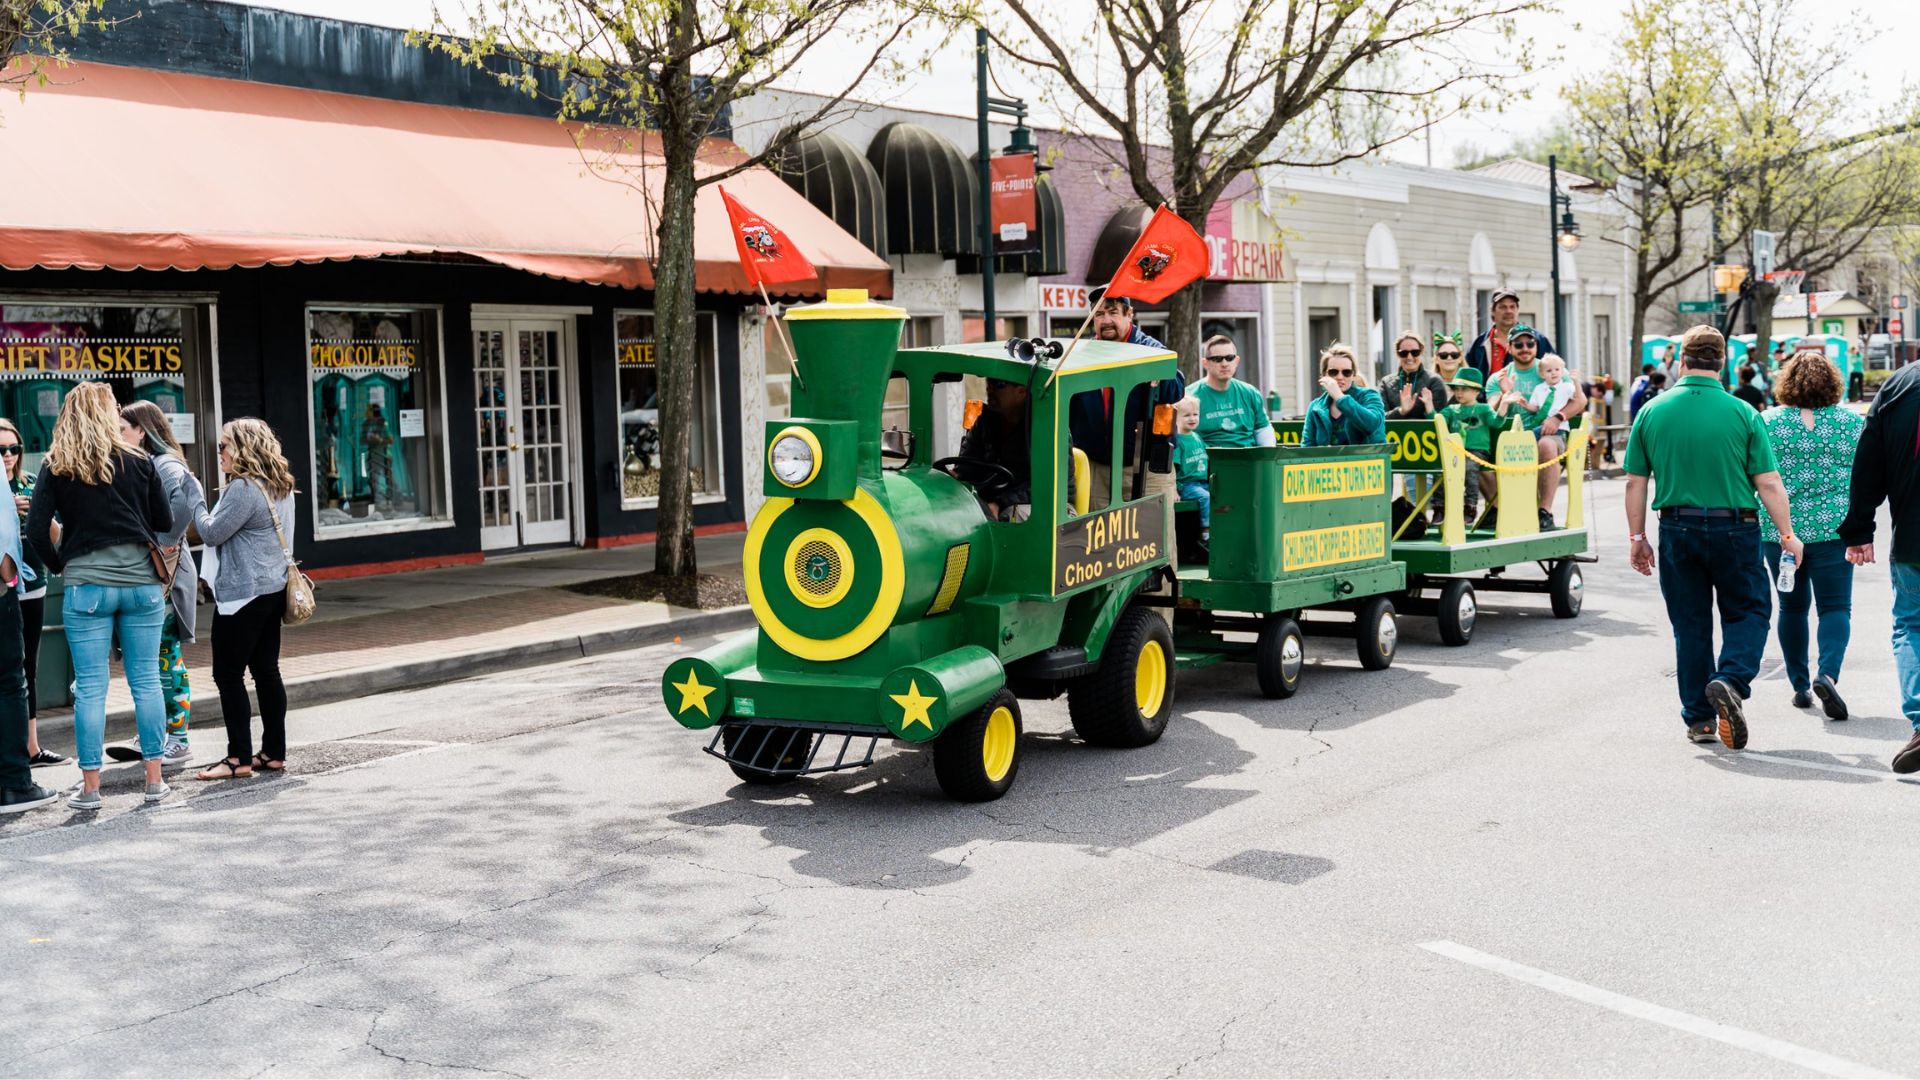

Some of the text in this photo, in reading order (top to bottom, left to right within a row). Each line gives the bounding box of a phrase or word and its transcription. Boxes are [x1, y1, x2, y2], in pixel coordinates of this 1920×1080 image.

[1232, 239, 1284, 279] REPAIR
[1043, 287, 1087, 308] KEYS
[59, 345, 182, 372] BASKETS
[311, 344, 416, 368] CHOCOLATES
[1286, 464, 1382, 497] OUR WHEELS TURN FOR
[1085, 507, 1139, 556] JAMIL
[1285, 534, 1318, 567] CHILDREN
[1320, 530, 1350, 561] CRIPPLED
[1358, 527, 1383, 556] BURNED
